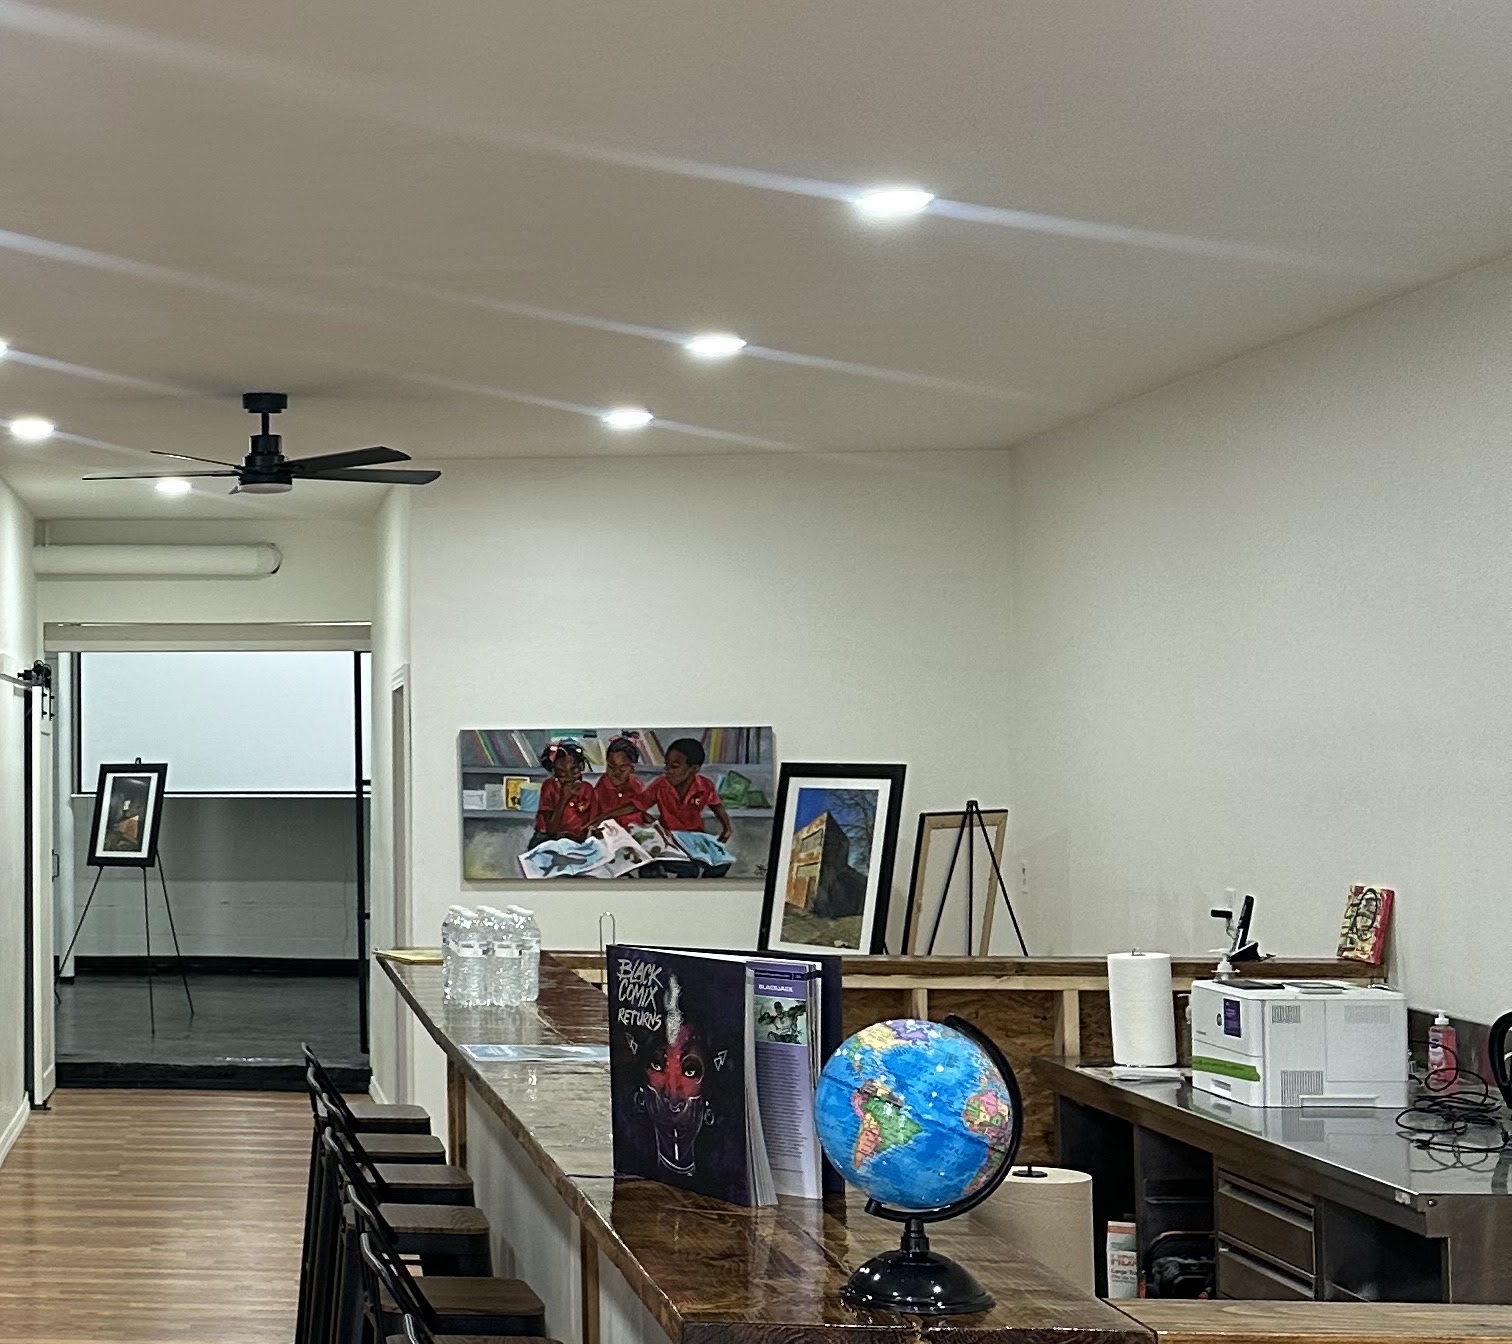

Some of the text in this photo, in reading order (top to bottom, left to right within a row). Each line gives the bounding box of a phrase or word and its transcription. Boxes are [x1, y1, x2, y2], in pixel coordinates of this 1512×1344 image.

[616, 958, 664, 989] BLACK
[618, 978, 659, 1013] COMIX
[617, 1007, 662, 1032] RETURNS
